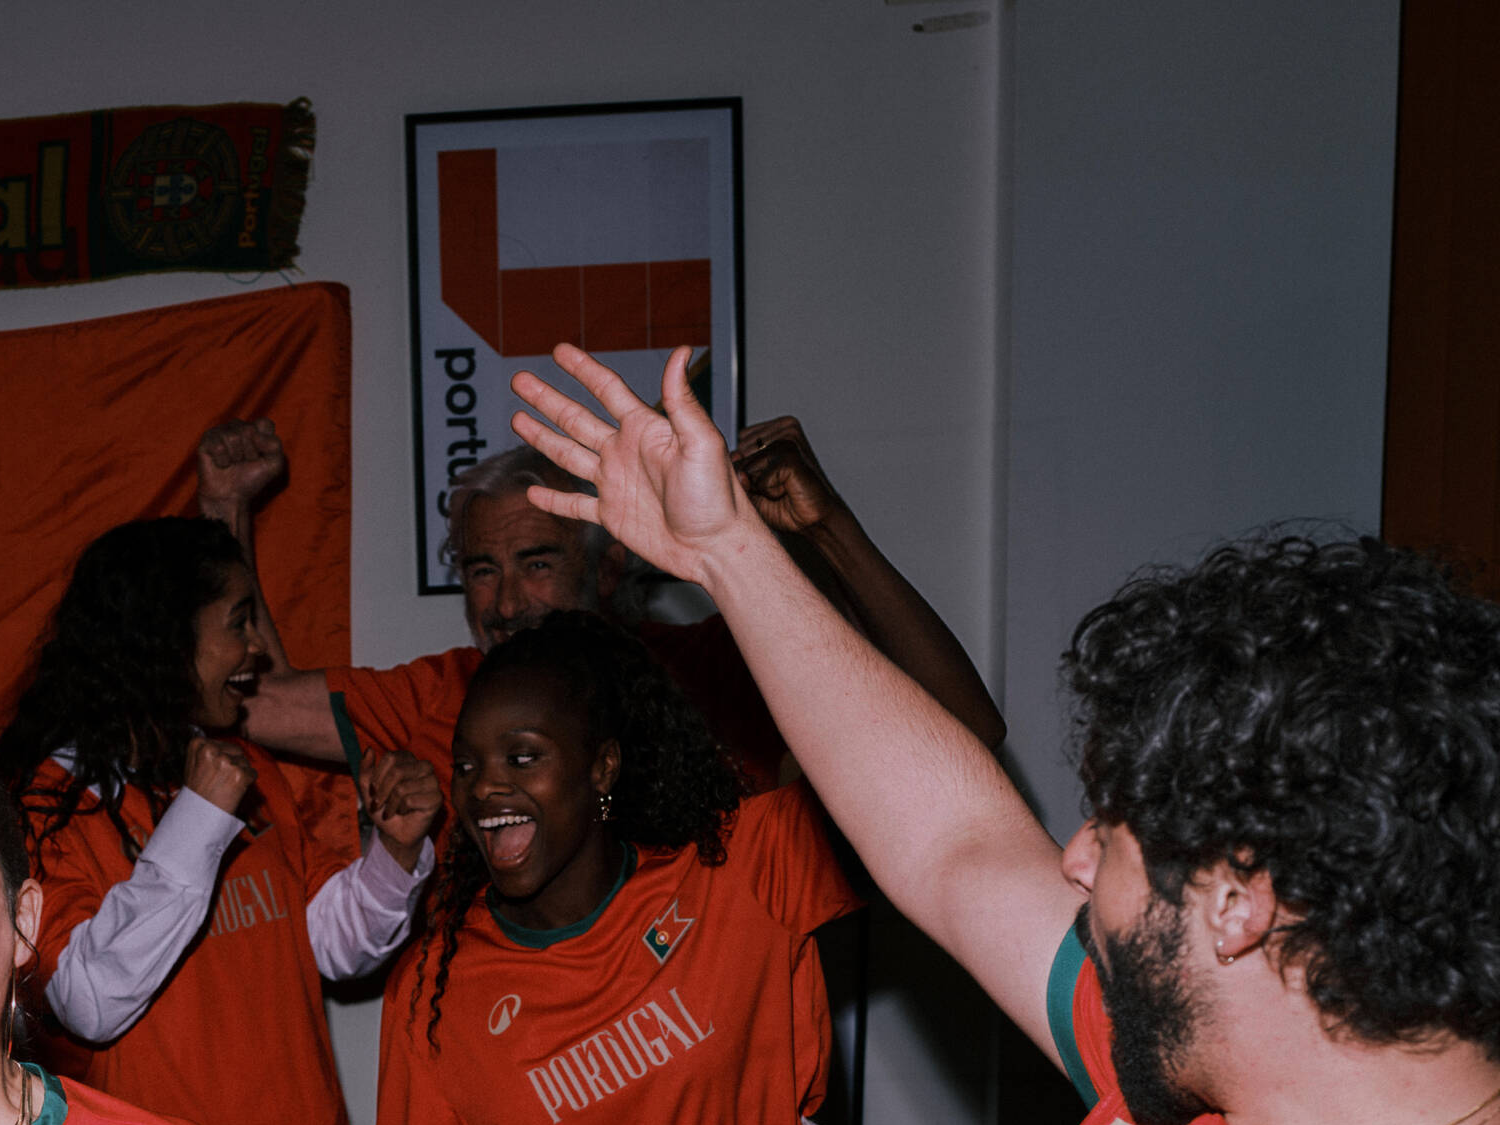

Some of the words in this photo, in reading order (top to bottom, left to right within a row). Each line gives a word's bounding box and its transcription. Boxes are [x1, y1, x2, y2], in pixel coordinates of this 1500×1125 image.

[237, 127, 269, 248] Portugal
[435, 348, 487, 518] portu
[208, 869, 288, 937] UGAL
[525, 986, 715, 1125] PORTUGAL
